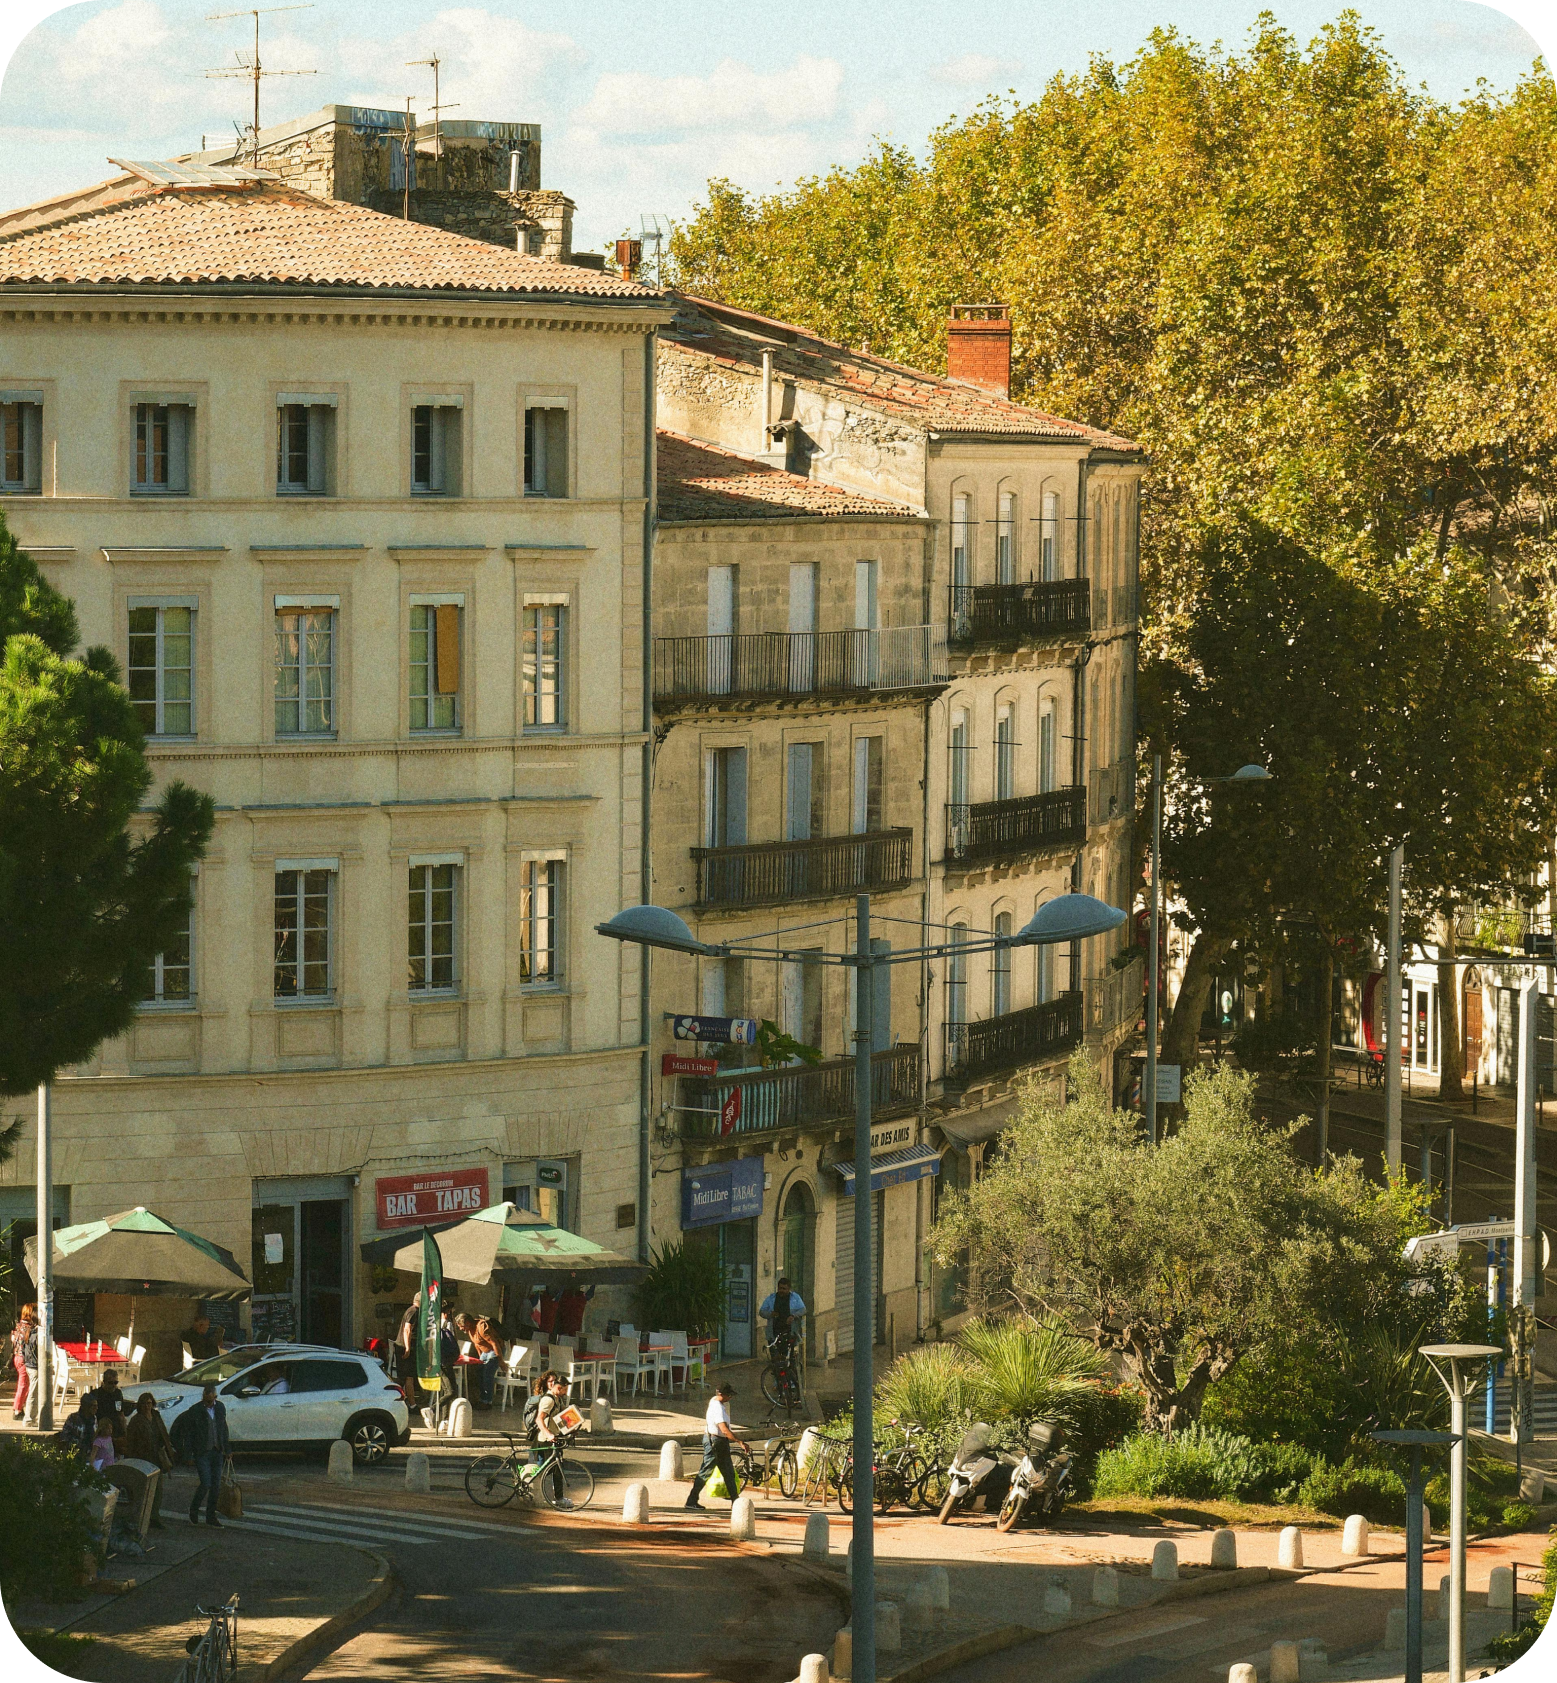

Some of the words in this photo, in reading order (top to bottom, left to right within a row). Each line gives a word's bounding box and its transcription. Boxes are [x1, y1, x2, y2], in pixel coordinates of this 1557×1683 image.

[672, 1062, 690, 1070] Midi
[691, 1063, 712, 1071] Libre
[725, 1100, 736, 1125] TABAC
[870, 1133, 880, 1148] AR
[880, 1130, 893, 1146] DES
[893, 1126, 910, 1143] AMIS
[386, 1194, 418, 1217] BAR
[435, 1187, 481, 1212] TAPAS
[732, 1183, 757, 1201] TABAC
